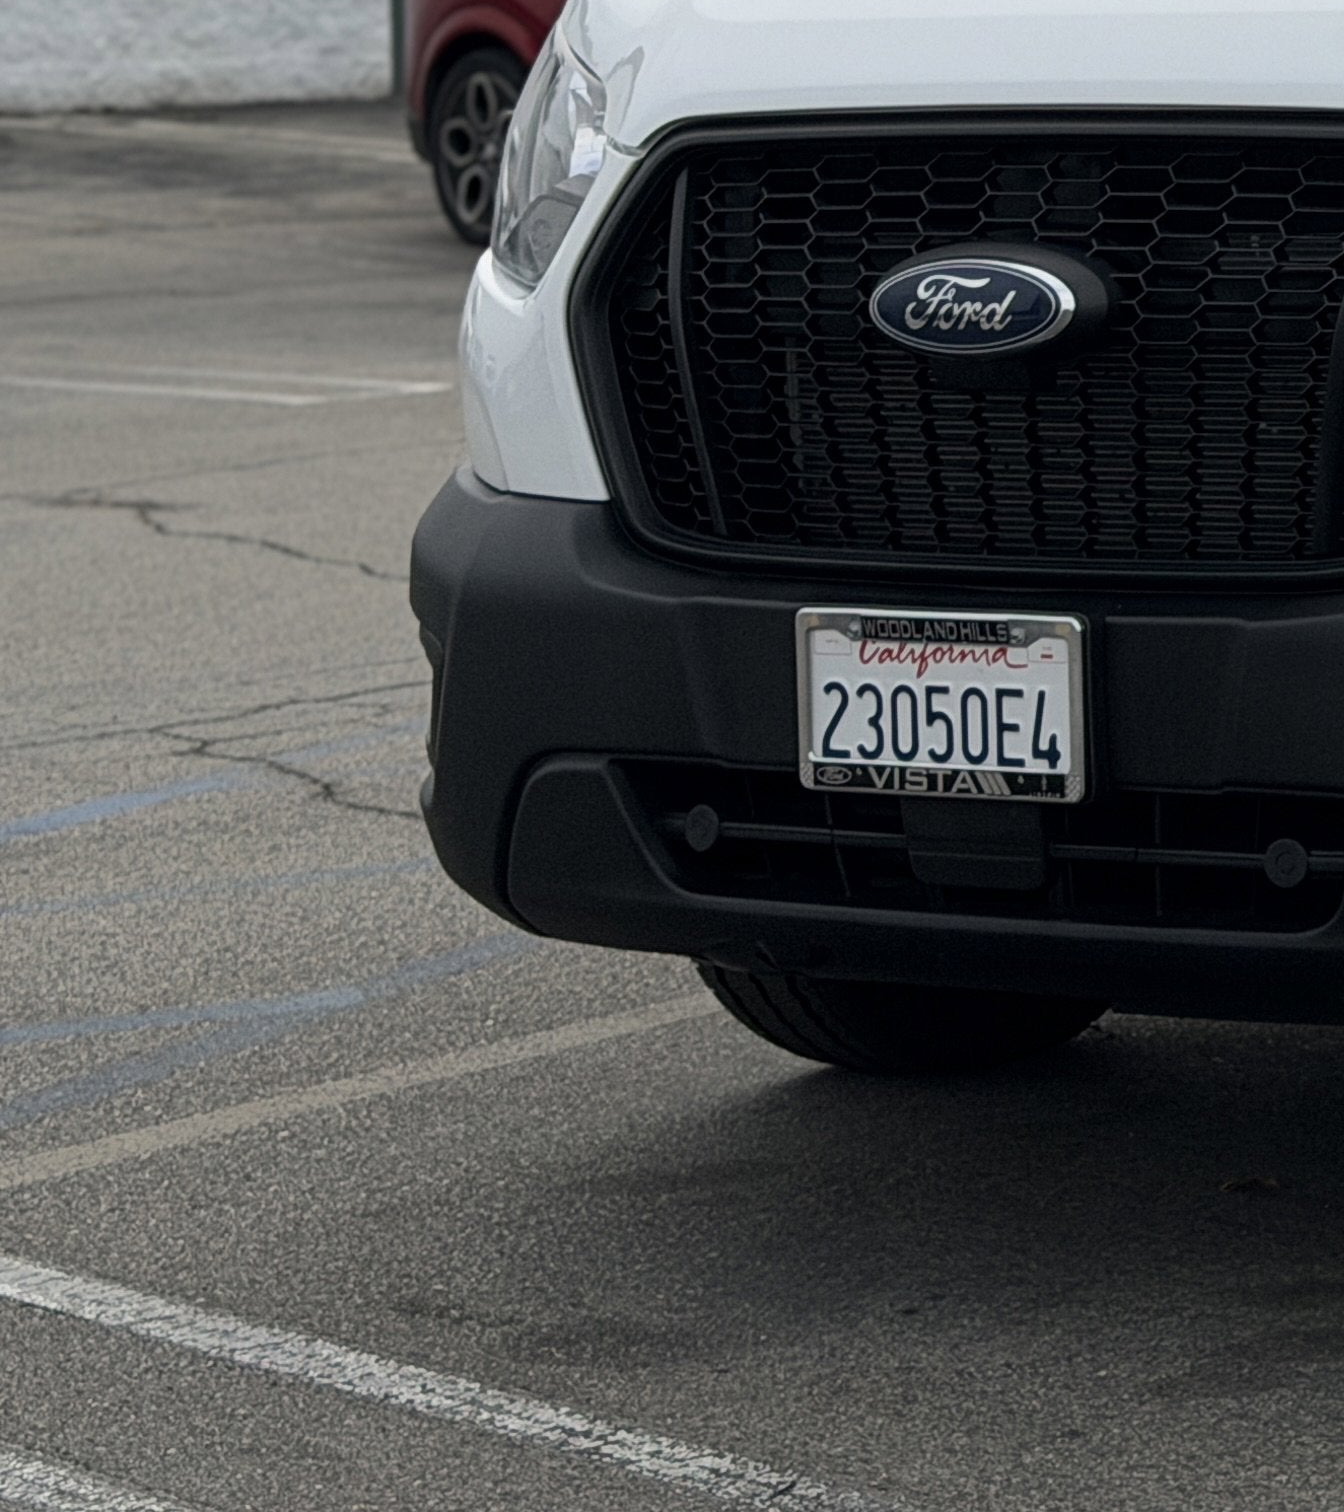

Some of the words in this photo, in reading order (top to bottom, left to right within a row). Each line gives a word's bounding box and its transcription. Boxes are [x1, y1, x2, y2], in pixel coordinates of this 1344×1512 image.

[904, 274, 1017, 331] Ford
[863, 618, 957, 640] WOODLAND
[962, 622, 1008, 643] HILLS
[859, 640, 1028, 678] California
[821, 681, 1062, 769] 23050E4
[868, 767, 978, 794] VISTA
